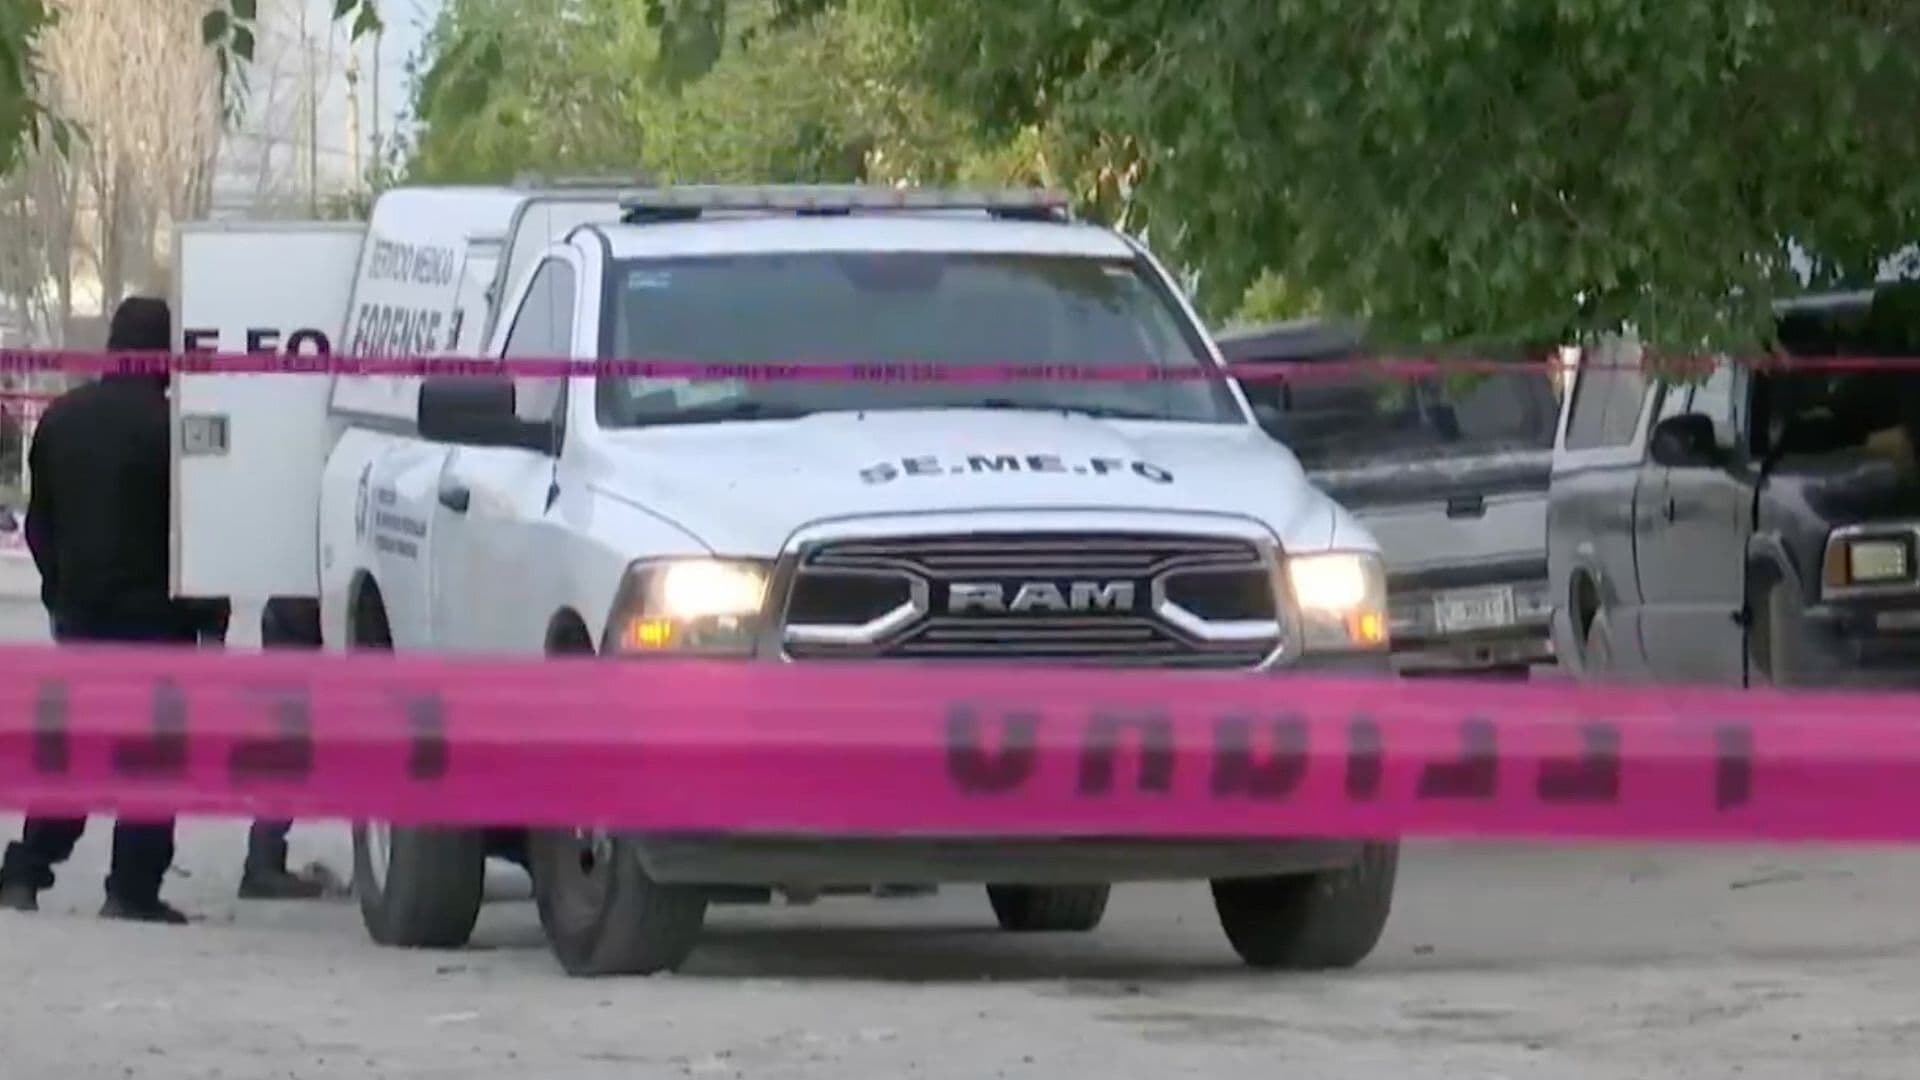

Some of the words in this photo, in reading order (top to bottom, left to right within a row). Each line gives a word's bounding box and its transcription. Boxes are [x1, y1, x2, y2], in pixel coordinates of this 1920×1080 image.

[352, 303, 441, 359] FORENSE
[858, 454, 1175, 485] SE.ME.FO
[948, 581, 1136, 614] RAM
